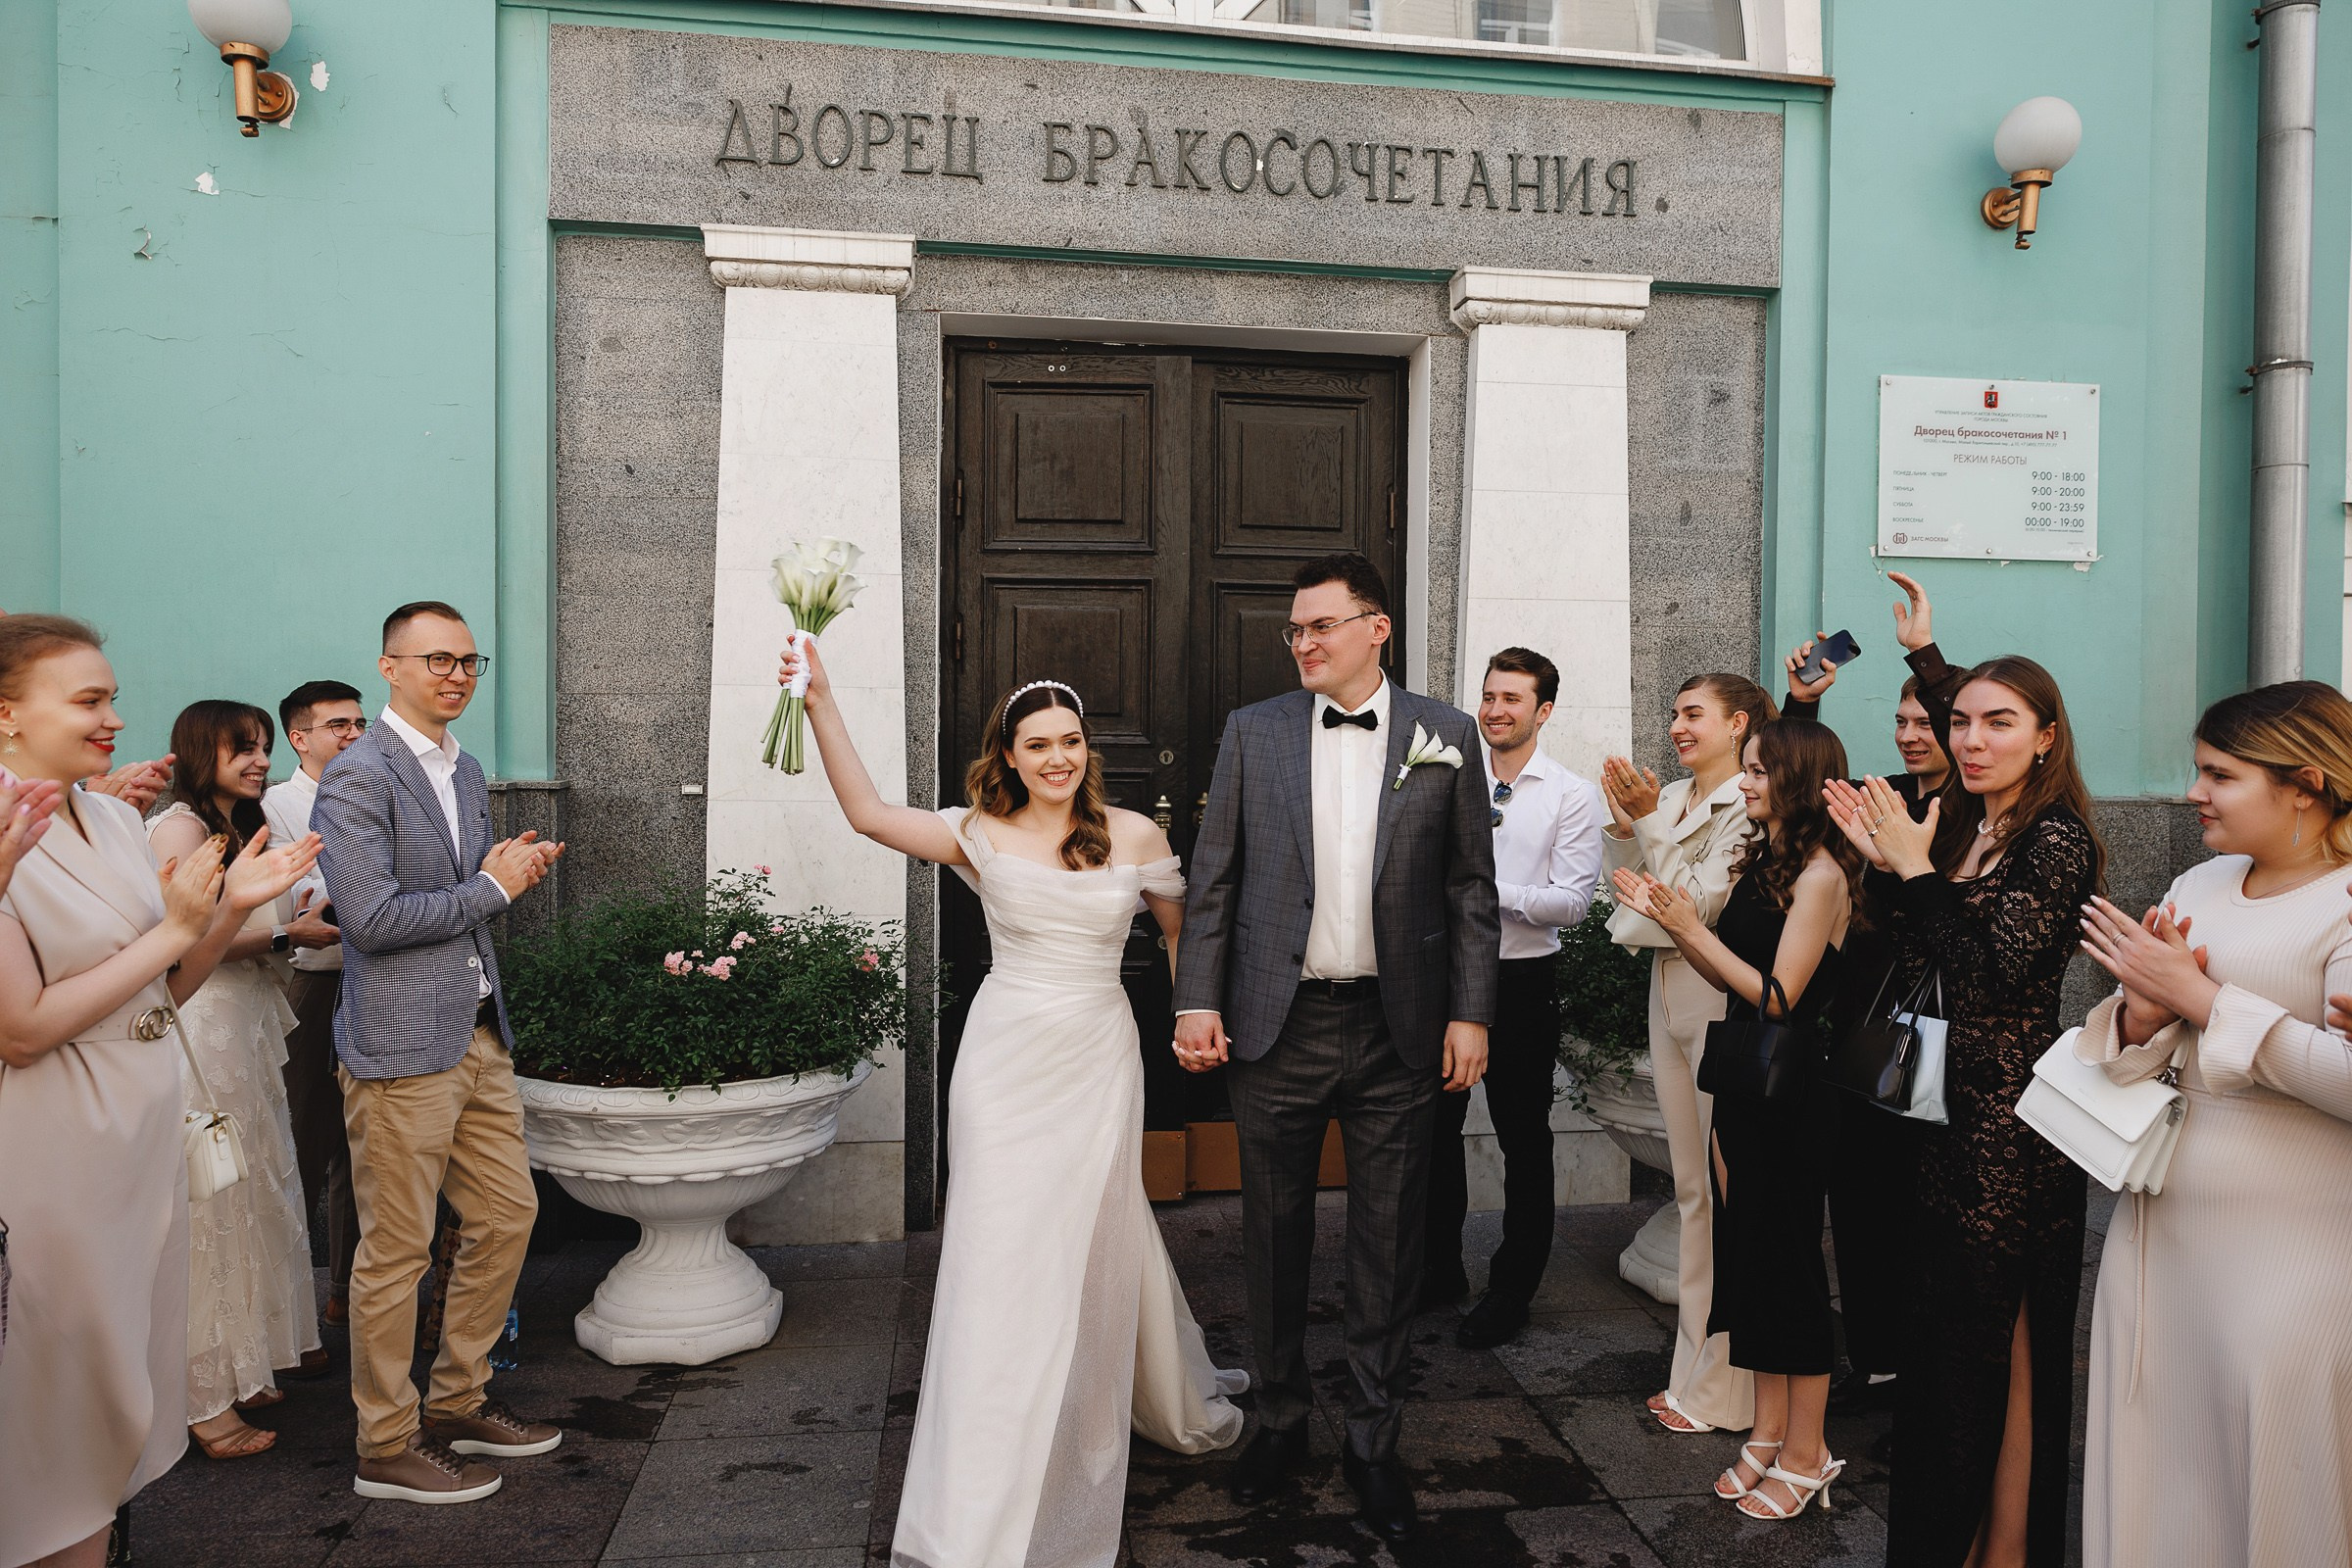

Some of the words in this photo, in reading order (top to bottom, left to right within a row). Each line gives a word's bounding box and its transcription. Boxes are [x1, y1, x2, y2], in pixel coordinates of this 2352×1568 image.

[715, 99, 983, 184] ДВОРЕЦ
[1042, 121, 1638, 217] БРАКОСОЧЕТАНИЯ
[1914, 425, 1955, 438] Дворец
[1957, 426, 2043, 440] бракосочетания
[2045, 430, 2059, 440] №
[2062, 431, 2067, 441] 1
[1953, 454, 1988, 465] РЕЖИМ
[1990, 455, 2028, 466] РАБОТЫ
[2032, 470, 2052, 481] 9:00
[2062, 471, 2085, 482] 18:00
[2032, 486, 2052, 496] 9:00
[2059, 487, 2085, 497] 20:00
[2031, 502, 2052, 512] 9:00
[2059, 502, 2084, 513] 23:59
[2025, 516, 2051, 527] 00:00
[2060, 517, 2084, 528] 19:00
